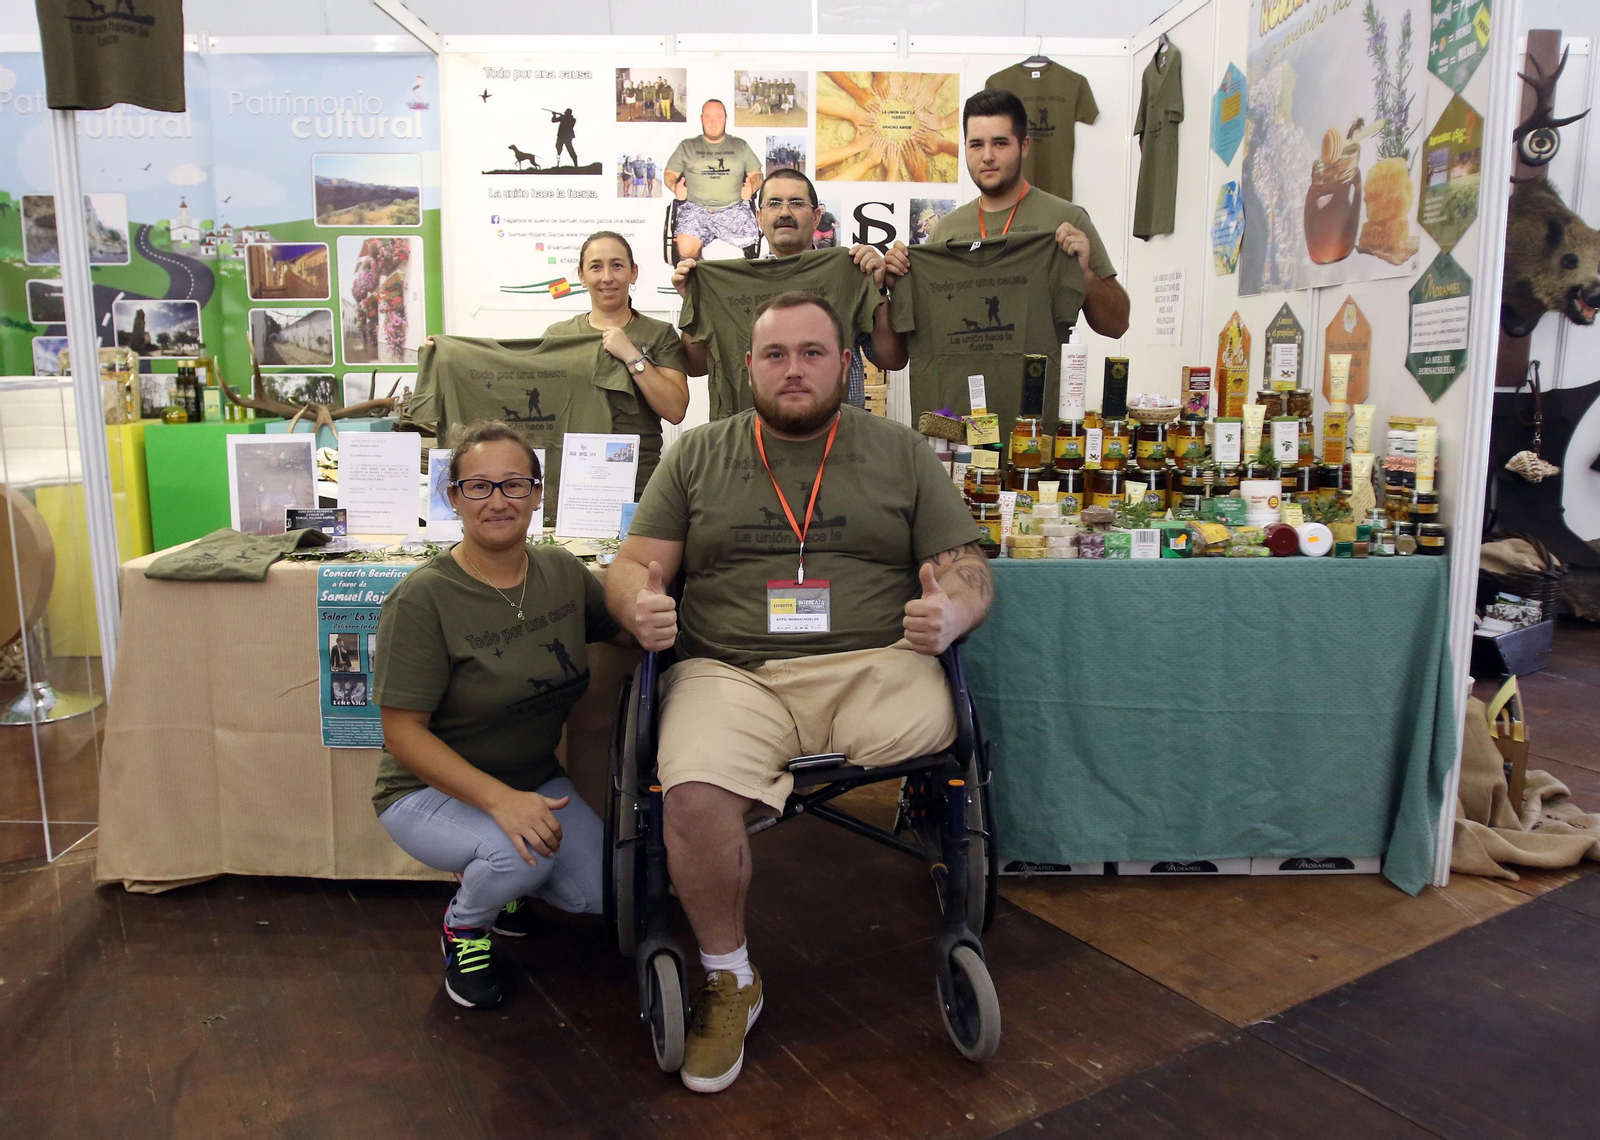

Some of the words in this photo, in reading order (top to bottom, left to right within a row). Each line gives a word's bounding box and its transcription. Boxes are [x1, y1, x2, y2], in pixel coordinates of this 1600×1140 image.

[483, 66, 511, 79] Todo
[513, 68, 532, 80] por
[534, 70, 556, 79] una
[558, 70, 592, 80] causa
[228, 90, 383, 116] Patrimonio
[291, 109, 422, 139] cultural
[488, 188, 501, 198] La
[503, 188, 529, 198] unión
[531, 188, 554, 198] hace
[556, 188, 566, 198] la
[567, 188, 597, 198] fuerza
[930, 281, 954, 293] Todo
[957, 280, 973, 292] por
[976, 278, 995, 288] una
[997, 276, 1028, 286] causa
[727, 294, 753, 307] Todo
[950, 336, 960, 344] La
[962, 333, 983, 343] unión
[985, 333, 1004, 342] hace
[1005, 332, 1012, 341] la
[969, 342, 994, 351] fuerza
[1425, 356, 1431, 364] LA
[469, 369, 494, 380] Todo
[496, 370, 513, 380] por
[516, 370, 536, 380] una
[537, 369, 567, 378] causa
[1418, 366, 1455, 375] HORNACHUELOS
[526, 423, 544, 431] hace
[546, 422, 554, 430] la
[724, 456, 757, 470] Todo
[760, 456, 786, 473] por
[790, 454, 818, 467] una
[734, 531, 752, 543] La
[756, 531, 792, 544] unión
[830, 529, 842, 541] la
[323, 568, 366, 578] Concierto
[368, 568, 408, 578] Benéfico
[320, 590, 363, 602] Samuel
[322, 612, 347, 620] Salón
[465, 630, 501, 650] Todo
[502, 624, 524, 644] por
[524, 615, 549, 633] una
[1296, 858, 1336, 869] MORAMIEL
